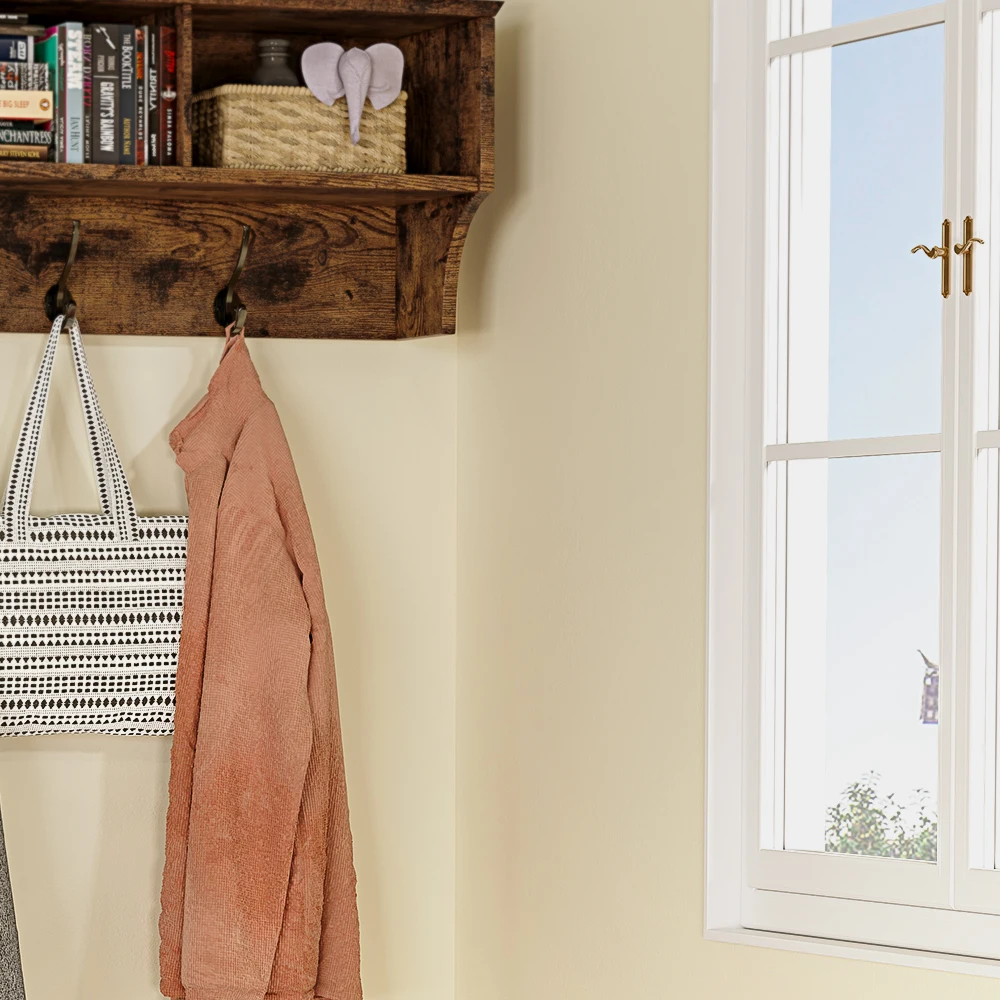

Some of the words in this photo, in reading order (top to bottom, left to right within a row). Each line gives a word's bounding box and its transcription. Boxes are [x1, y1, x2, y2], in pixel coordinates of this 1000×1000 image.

[123, 34, 131, 45] THE
[67, 29, 83, 90] STEAM
[2, 100, 13, 108] BIG
[14, 100, 30, 109] SLEEP
[100, 81, 114, 118] GRAVITY'S
[70, 117, 80, 130] IAN
[70, 131, 80, 152] HUNT
[100, 119, 114, 152] RAINBOW
